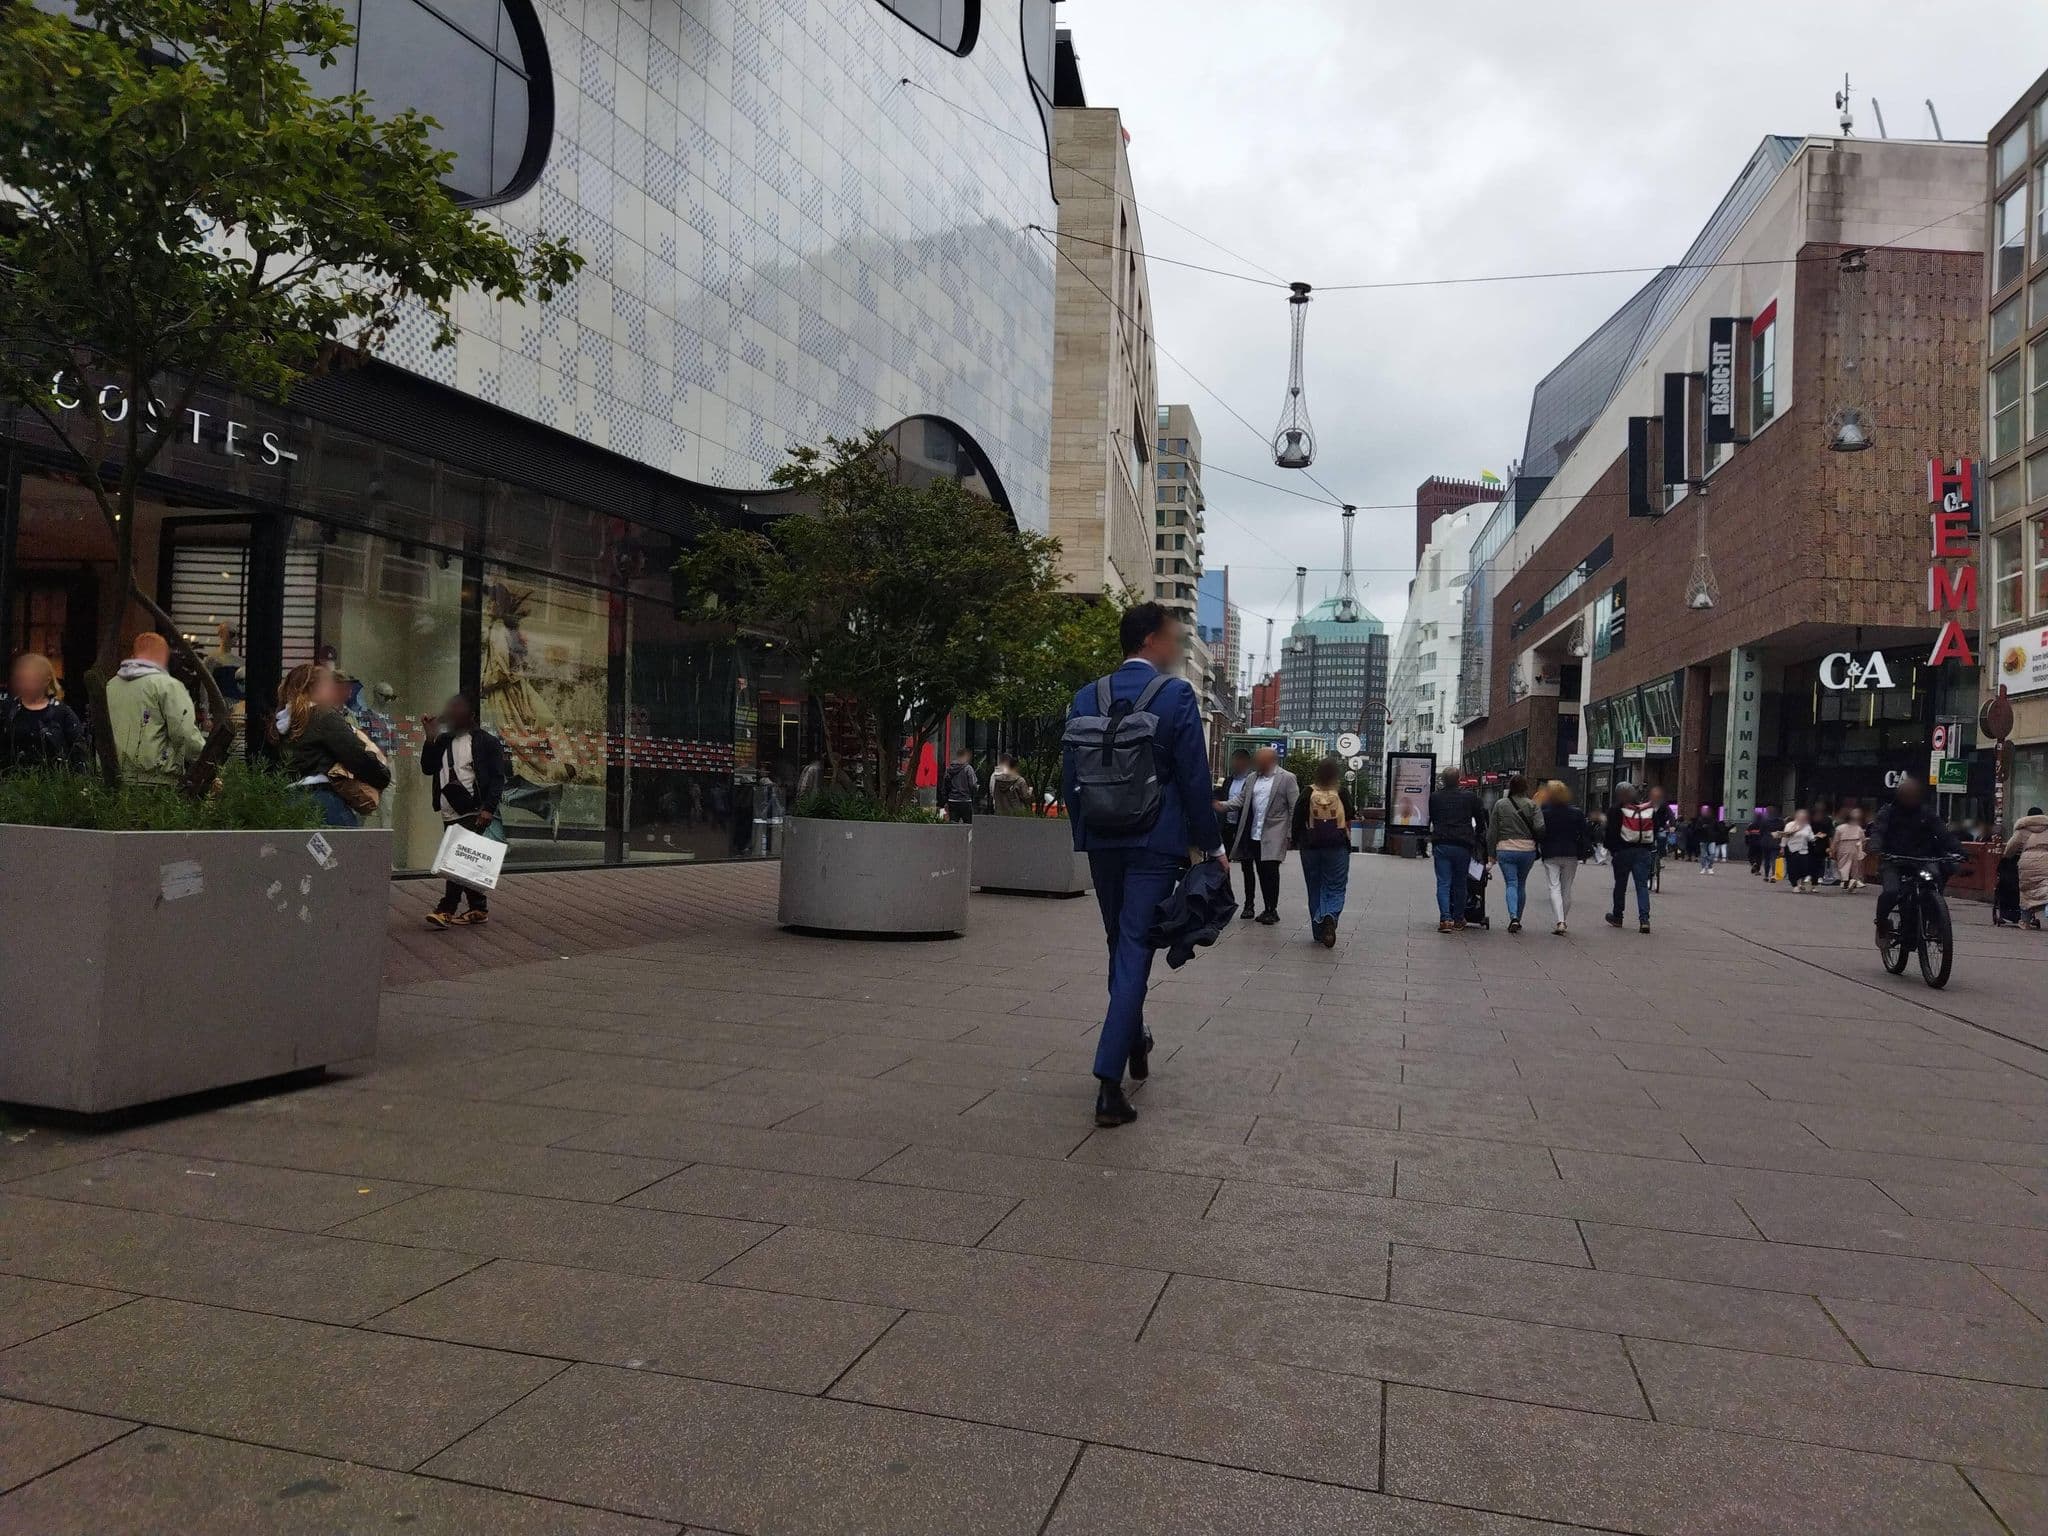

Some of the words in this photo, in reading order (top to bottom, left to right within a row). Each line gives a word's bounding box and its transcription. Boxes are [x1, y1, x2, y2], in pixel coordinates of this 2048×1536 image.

[1927, 457, 1978, 667] HEMA
[1819, 650, 1897, 690] C&A
[1736, 651, 1755, 820] SPUIMARKT
[454, 849, 480, 863] SPIRIT
[456, 843, 492, 863] SNEAKER
